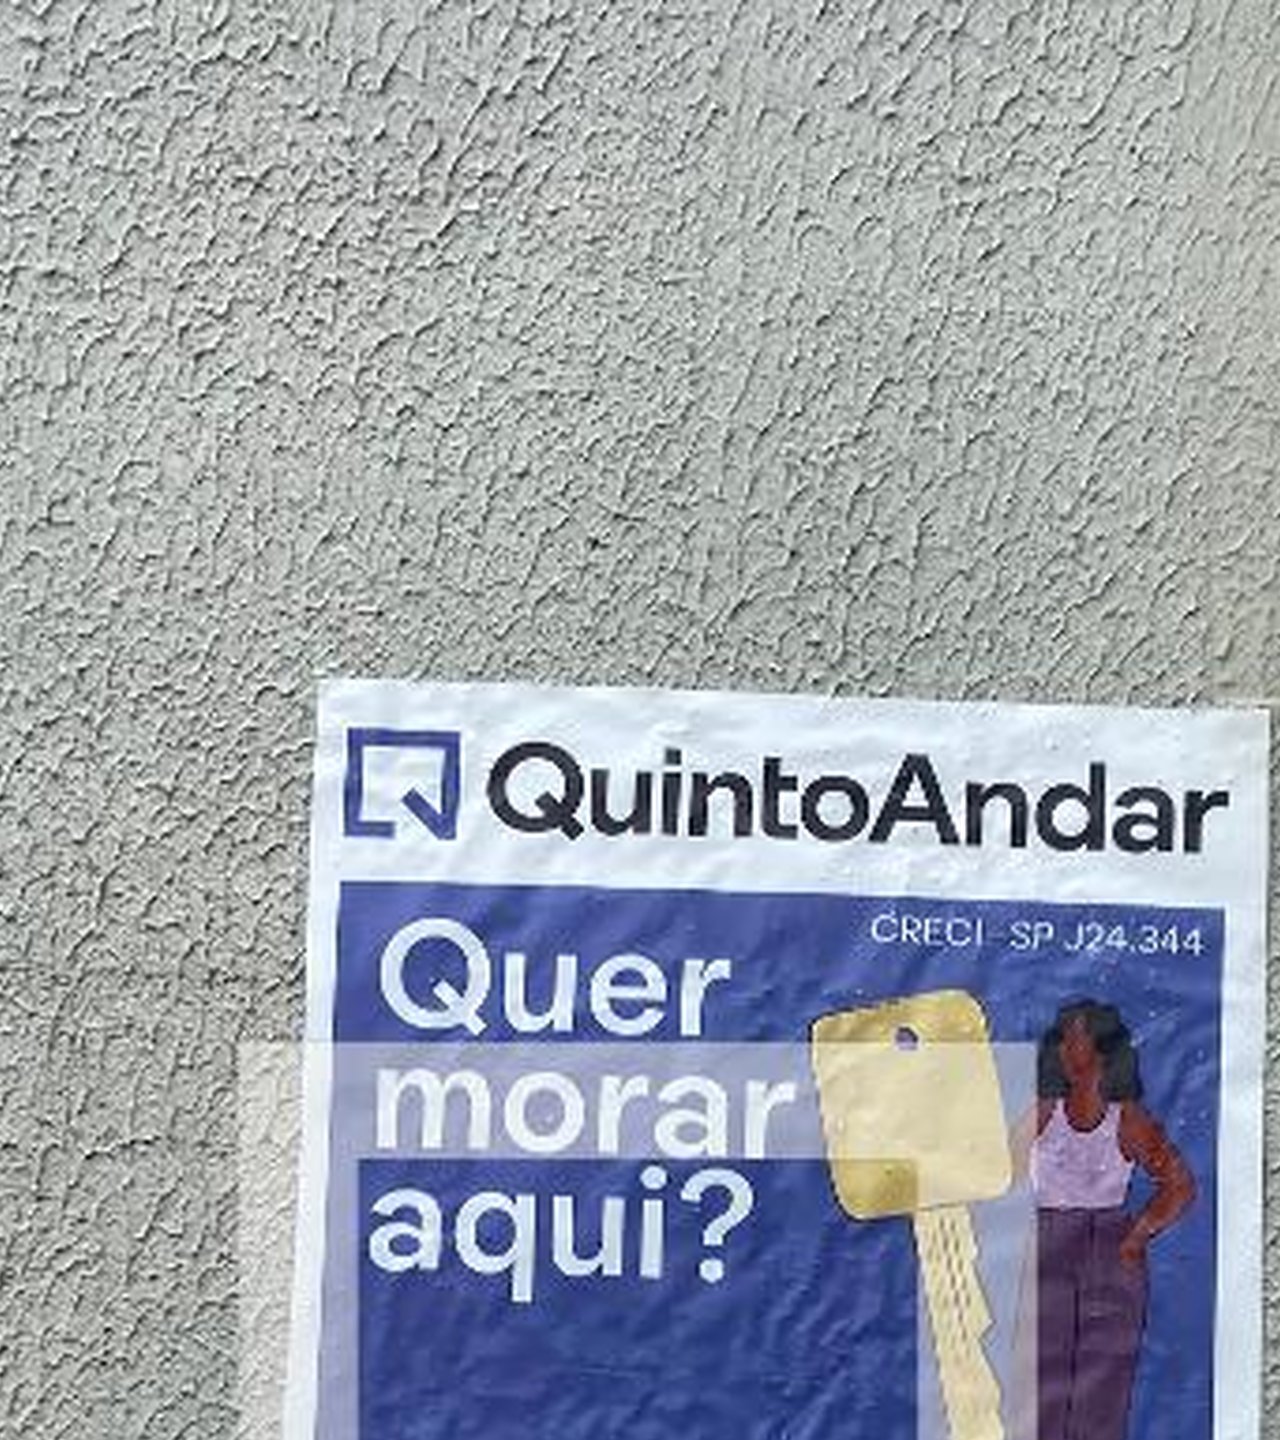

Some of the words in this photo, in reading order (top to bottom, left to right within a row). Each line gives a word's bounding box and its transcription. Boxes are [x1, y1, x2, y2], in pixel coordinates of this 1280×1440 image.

[485, 740, 1231, 854] QuintoAndar
[379, 915, 732, 1037] Quer
[1065, 921, 1206, 956] J24.344
[374, 1066, 797, 1160] morar
[367, 1166, 756, 1303] aqui?
